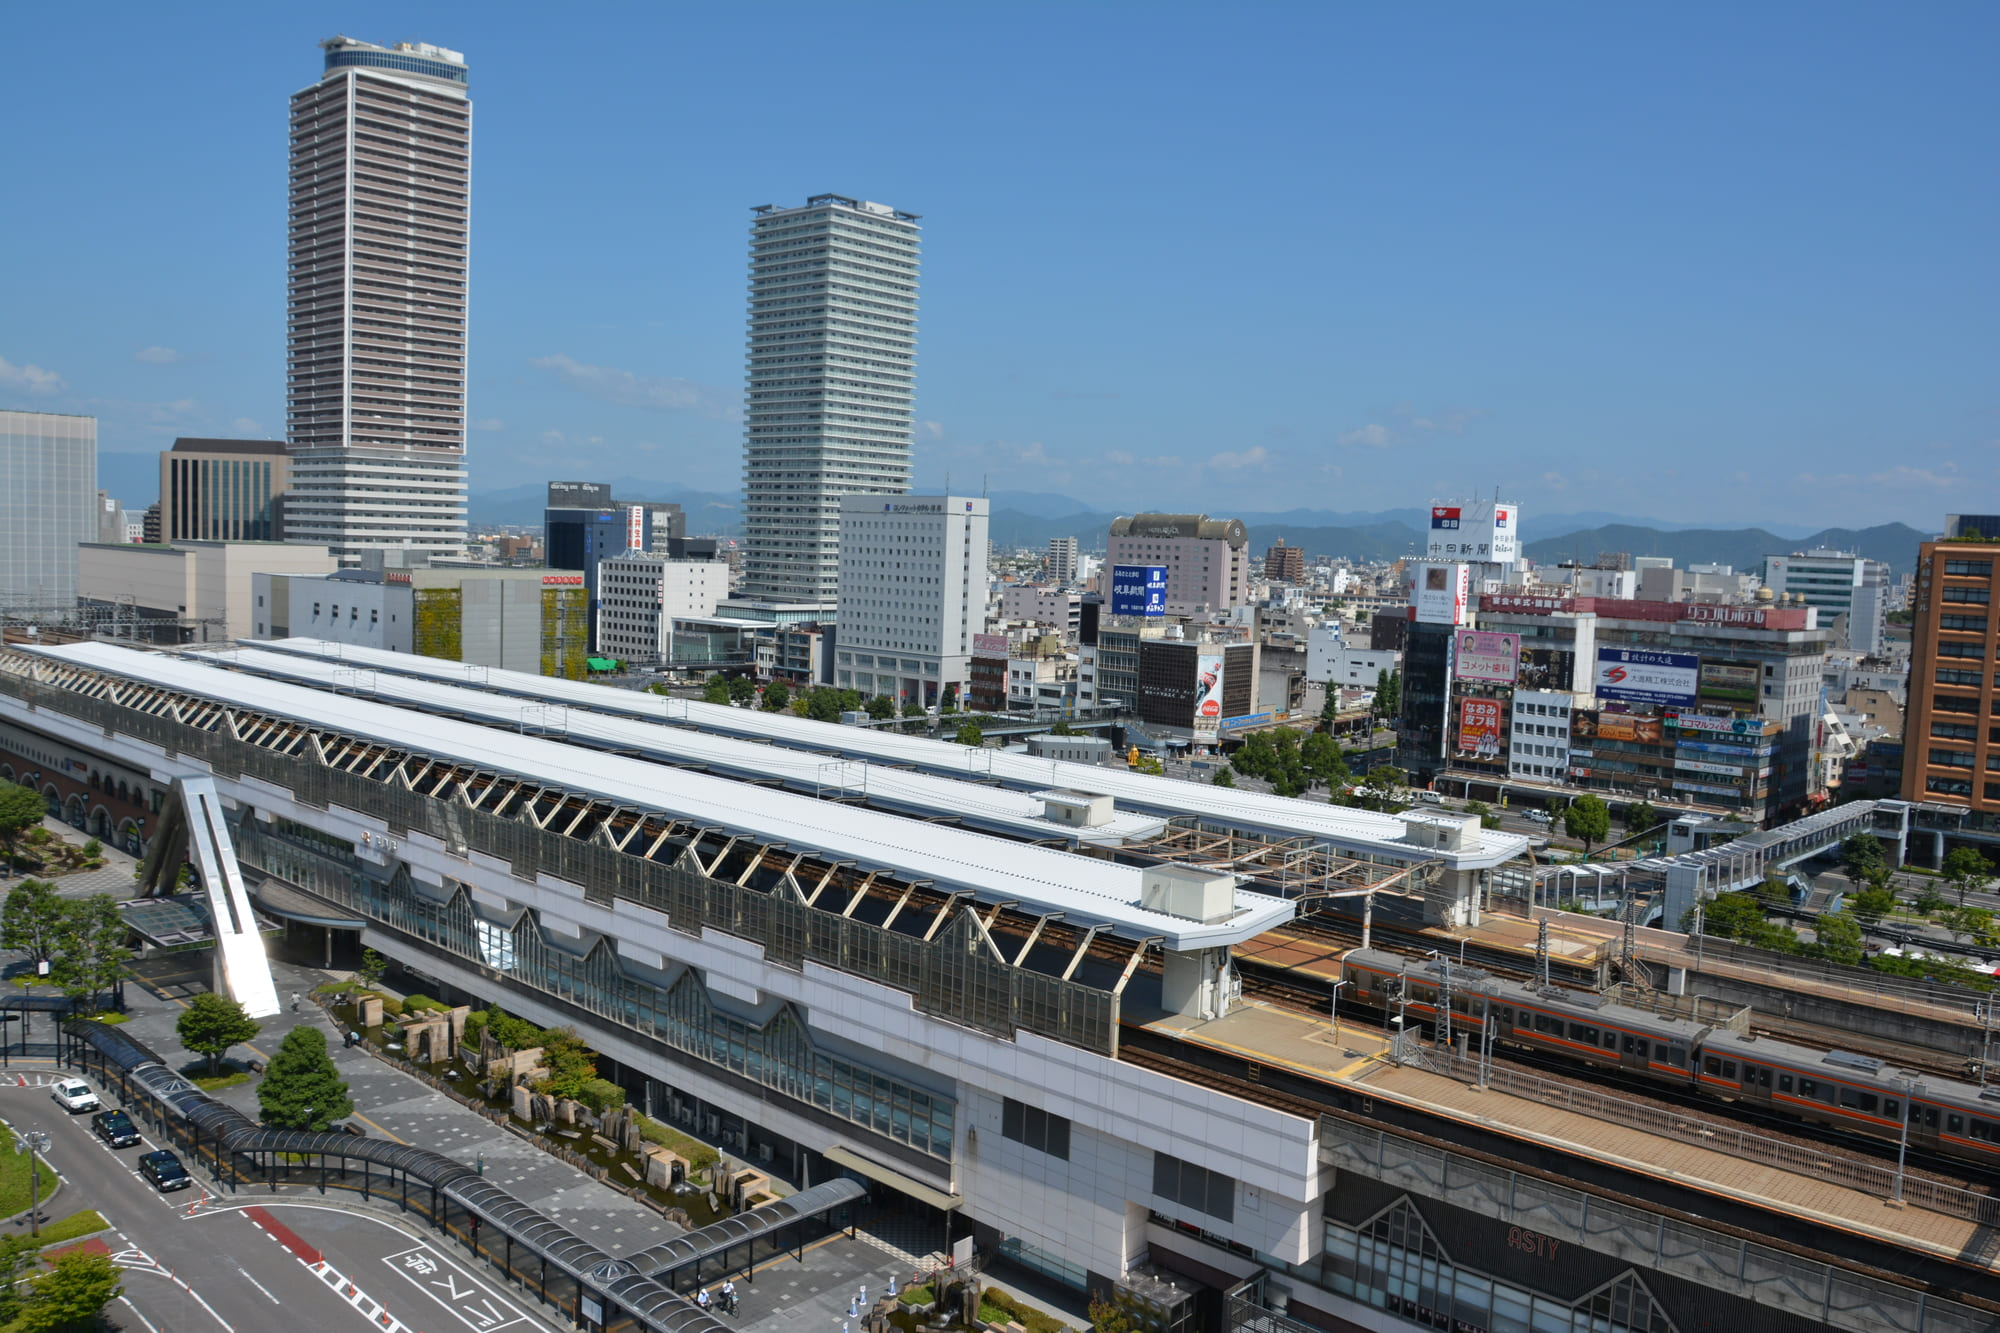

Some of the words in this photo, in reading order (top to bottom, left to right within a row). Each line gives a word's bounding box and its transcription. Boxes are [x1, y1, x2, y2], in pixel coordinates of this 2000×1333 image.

[1441, 520, 1458, 528] 中日
[1430, 541, 1489, 555] 中日新聞
[1462, 661, 1510, 672] コメット歯科
[1465, 703, 1496, 715] なおみ
[1464, 714, 1496, 728] 皮フ科
[1508, 1227, 1560, 1260] ASTY
